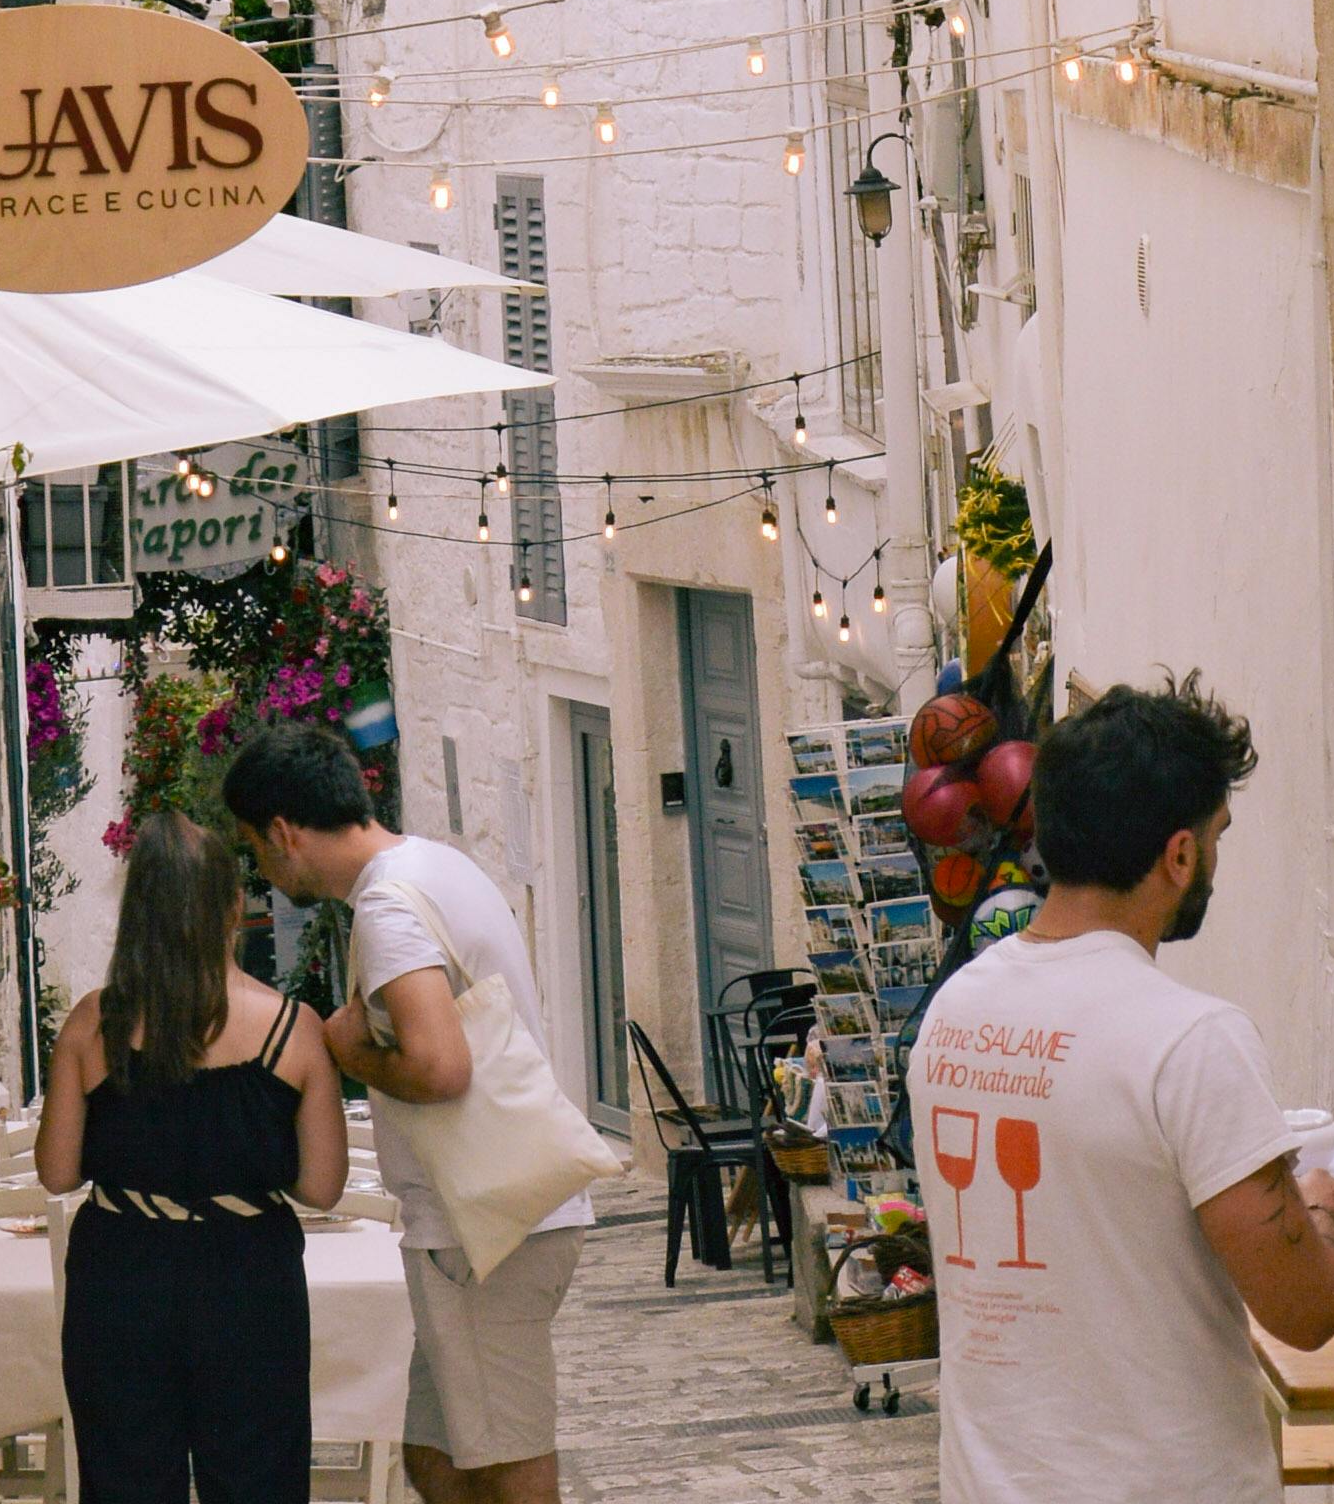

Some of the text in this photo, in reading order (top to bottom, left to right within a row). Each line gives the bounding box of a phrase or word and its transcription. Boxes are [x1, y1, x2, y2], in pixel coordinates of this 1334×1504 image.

[105, 191, 122, 213] E
[135, 184, 266, 212] CUCINA
[229, 450, 298, 496] dei
[925, 1018, 1077, 1062] Pane SALAME
[925, 1054, 1054, 1100] Vino naturale
